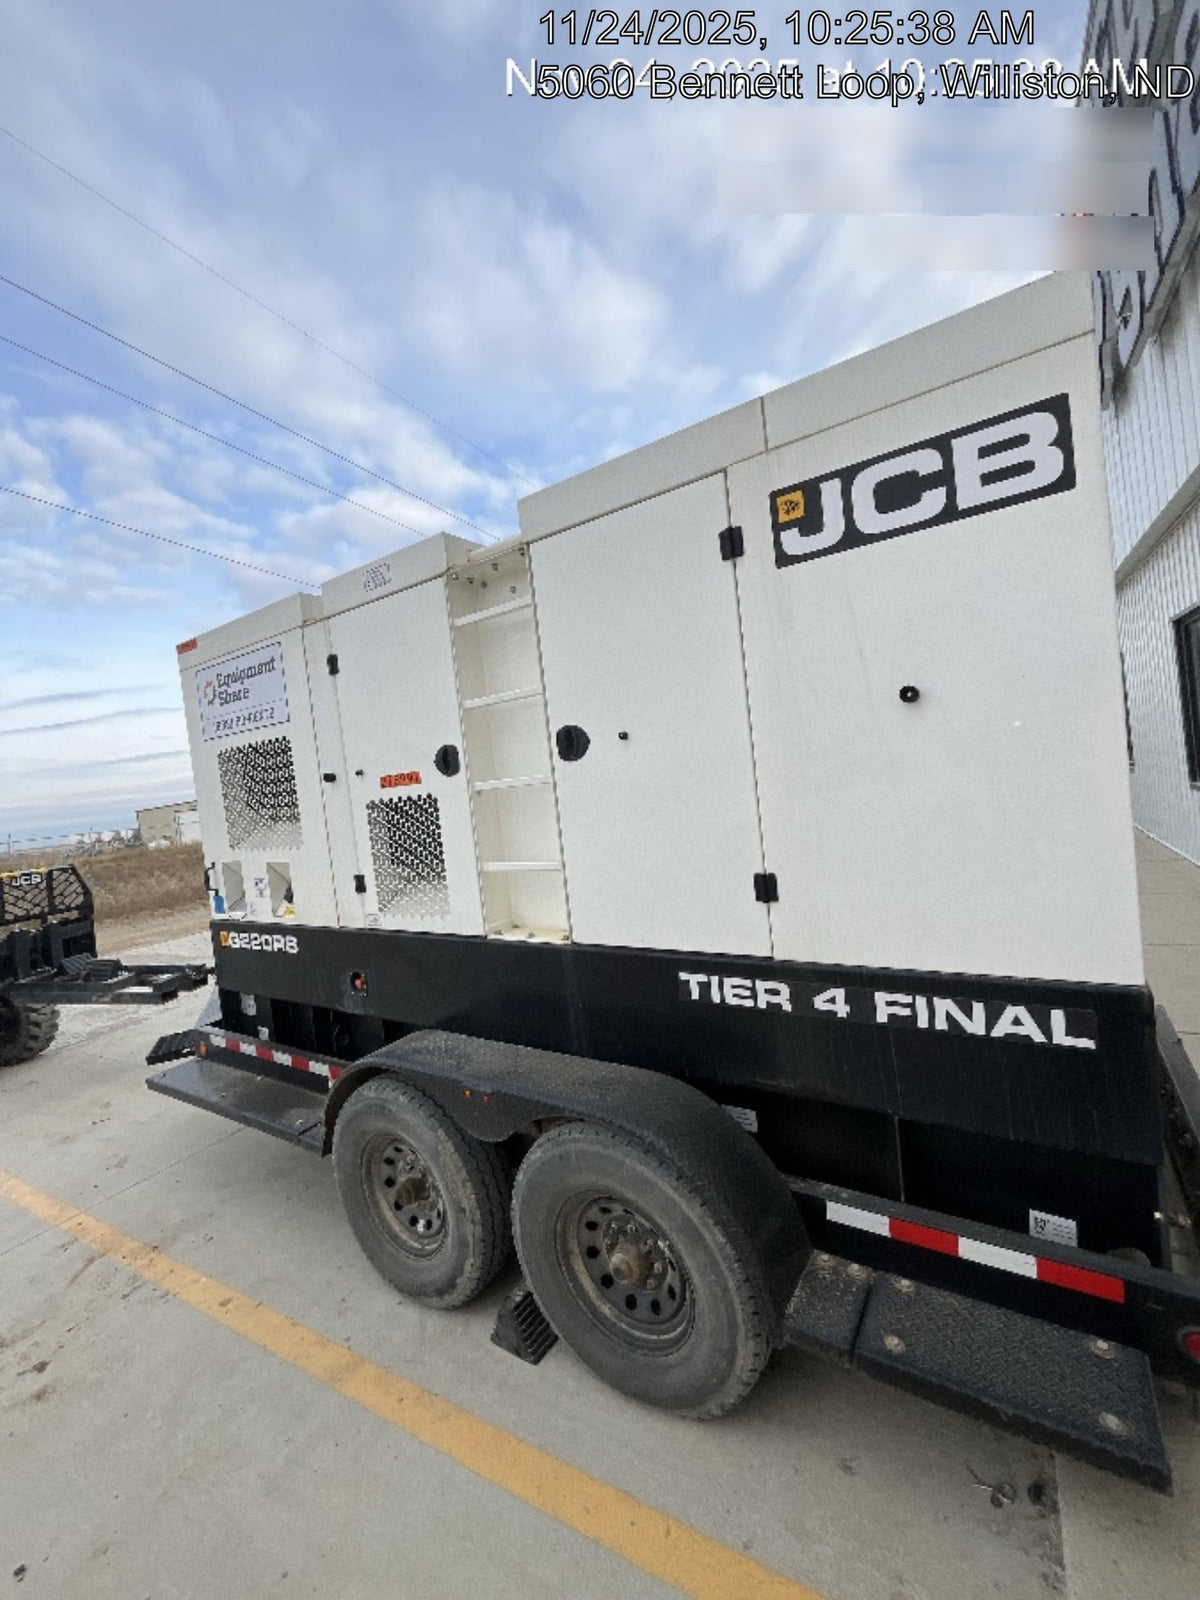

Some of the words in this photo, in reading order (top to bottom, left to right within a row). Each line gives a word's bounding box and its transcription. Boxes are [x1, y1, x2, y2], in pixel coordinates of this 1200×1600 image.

[779, 411, 1065, 556] JCB
[11, 874, 42, 886] JCB
[678, 972, 792, 1012] TIER
[812, 987, 851, 1018] 4
[874, 991, 1097, 1049] FINAL
